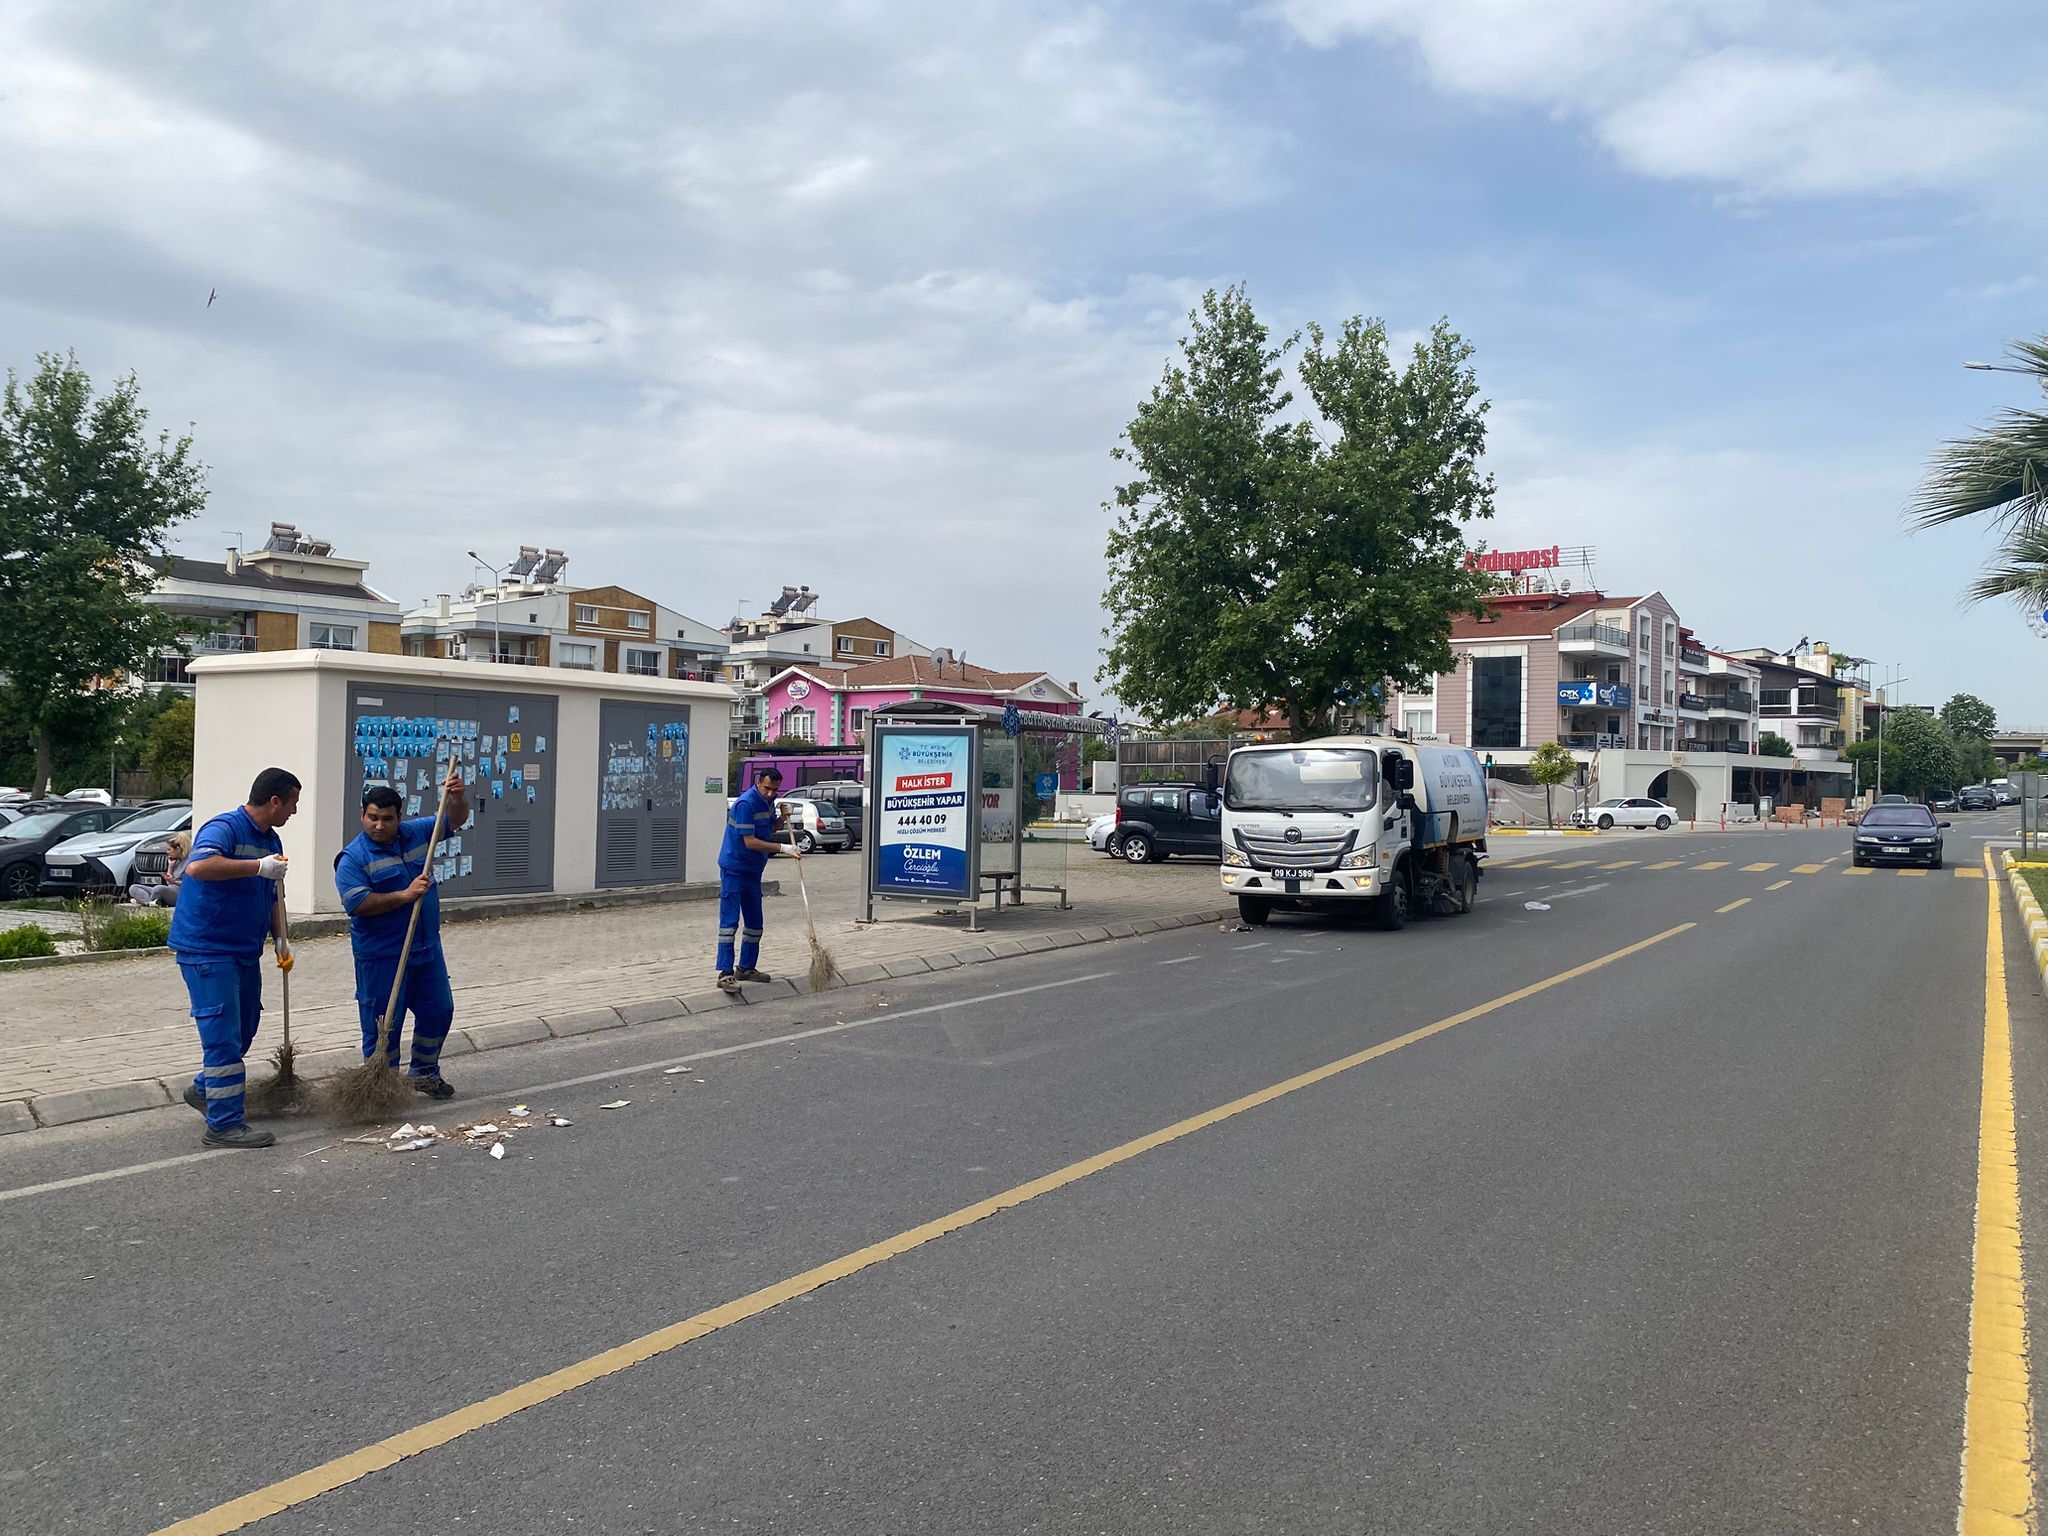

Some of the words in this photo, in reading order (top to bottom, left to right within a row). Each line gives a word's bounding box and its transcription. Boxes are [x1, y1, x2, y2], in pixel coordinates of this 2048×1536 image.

[912, 750, 953, 759] BÜYÜKŞEHİR
[901, 778, 923, 788] HALK
[924, 776, 946, 787] İSTER
[887, 796, 935, 810] BÜYÜKŞEHİR
[936, 795, 963, 806] YAPAR
[897, 816, 917, 826] 444
[920, 815, 932, 825] 40
[934, 814, 947, 824] 09
[909, 827, 926, 835] ÇÖZÜM
[903, 845, 942, 860] ÖZLEM
[1274, 869, 1284, 877] 09
[1285, 869, 1297, 877] KJ
